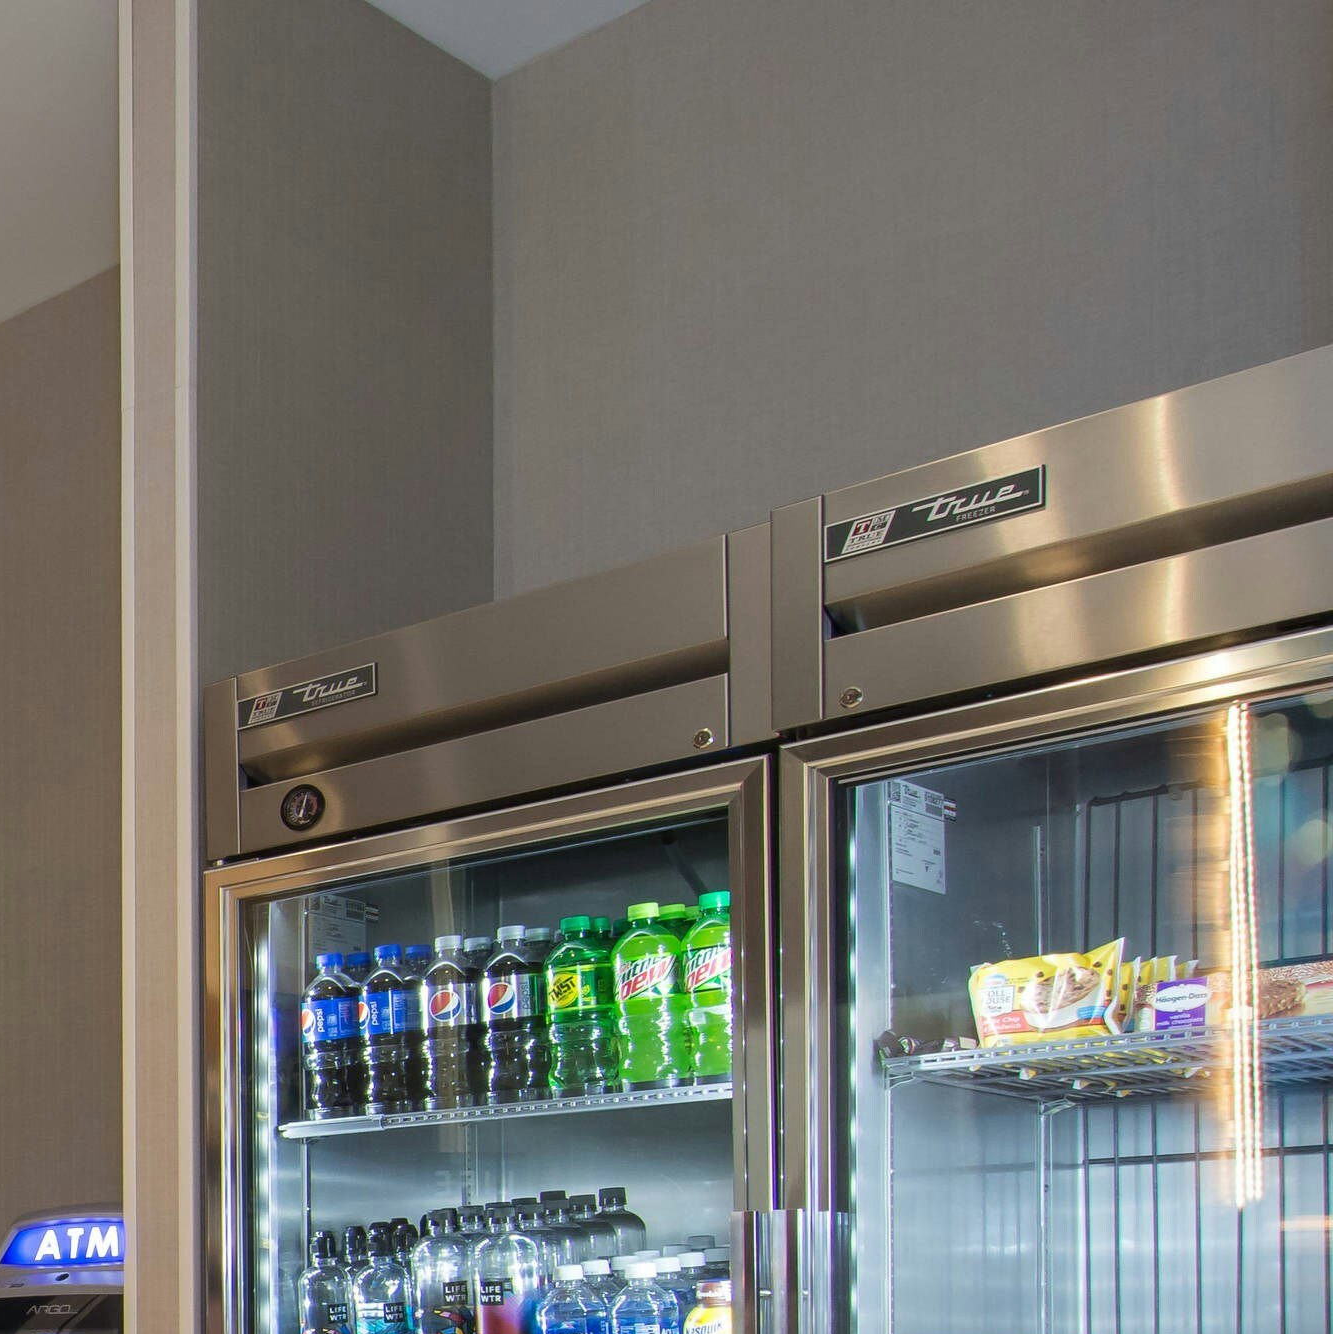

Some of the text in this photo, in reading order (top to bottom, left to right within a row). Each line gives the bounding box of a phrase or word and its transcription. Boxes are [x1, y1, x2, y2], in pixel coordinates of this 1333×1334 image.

[956, 506, 996, 522] FREEZER
[316, 1008, 325, 1033] pepsi
[370, 1001, 380, 1026] pepsi
[34, 1225, 118, 1262] ATM
